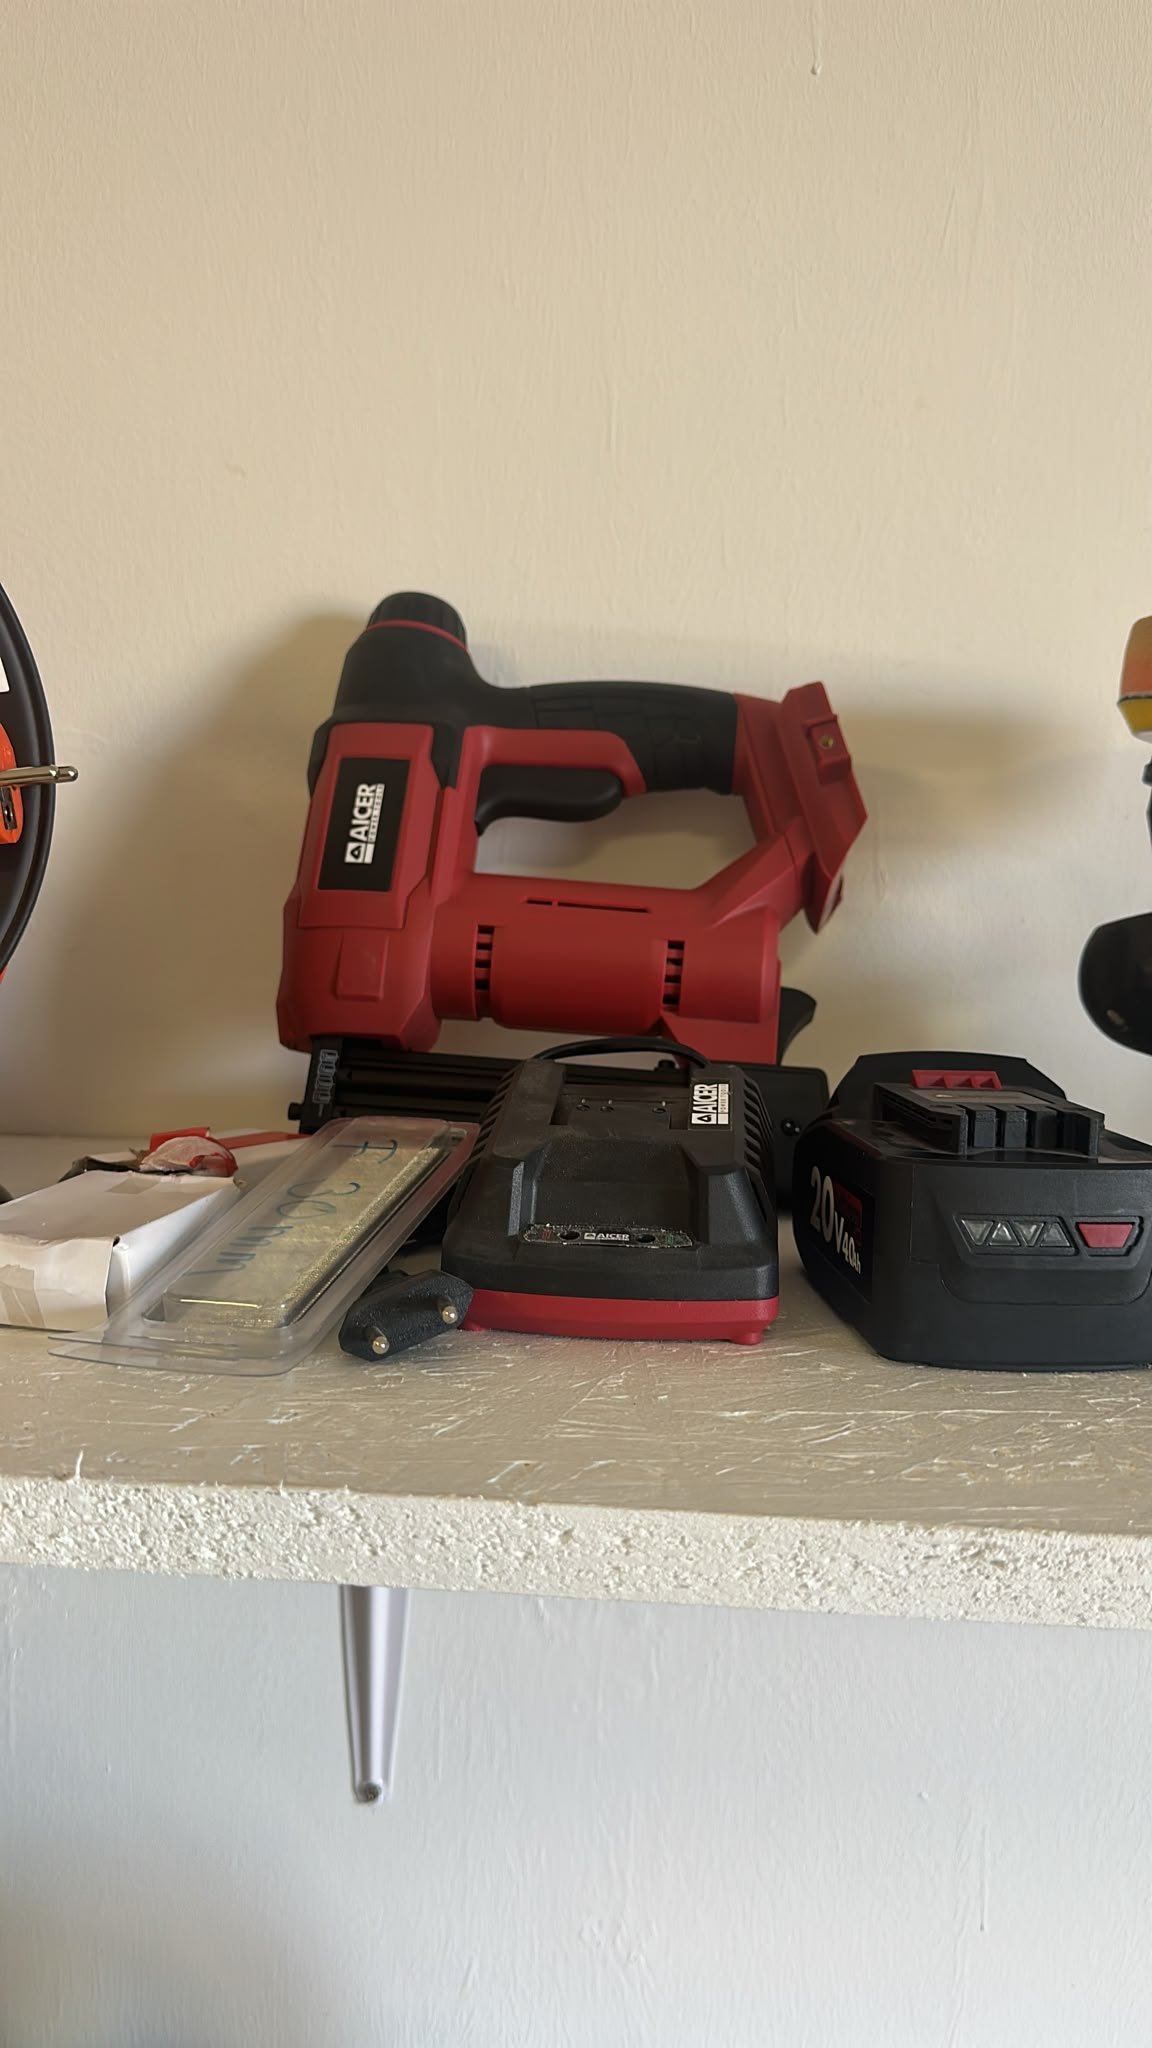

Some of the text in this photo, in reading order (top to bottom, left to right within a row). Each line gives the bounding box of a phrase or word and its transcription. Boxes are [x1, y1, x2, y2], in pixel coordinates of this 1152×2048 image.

[349, 784, 376, 842] AICER
[693, 1083, 718, 1113] AICER
[596, 1232, 630, 1241] AICER
